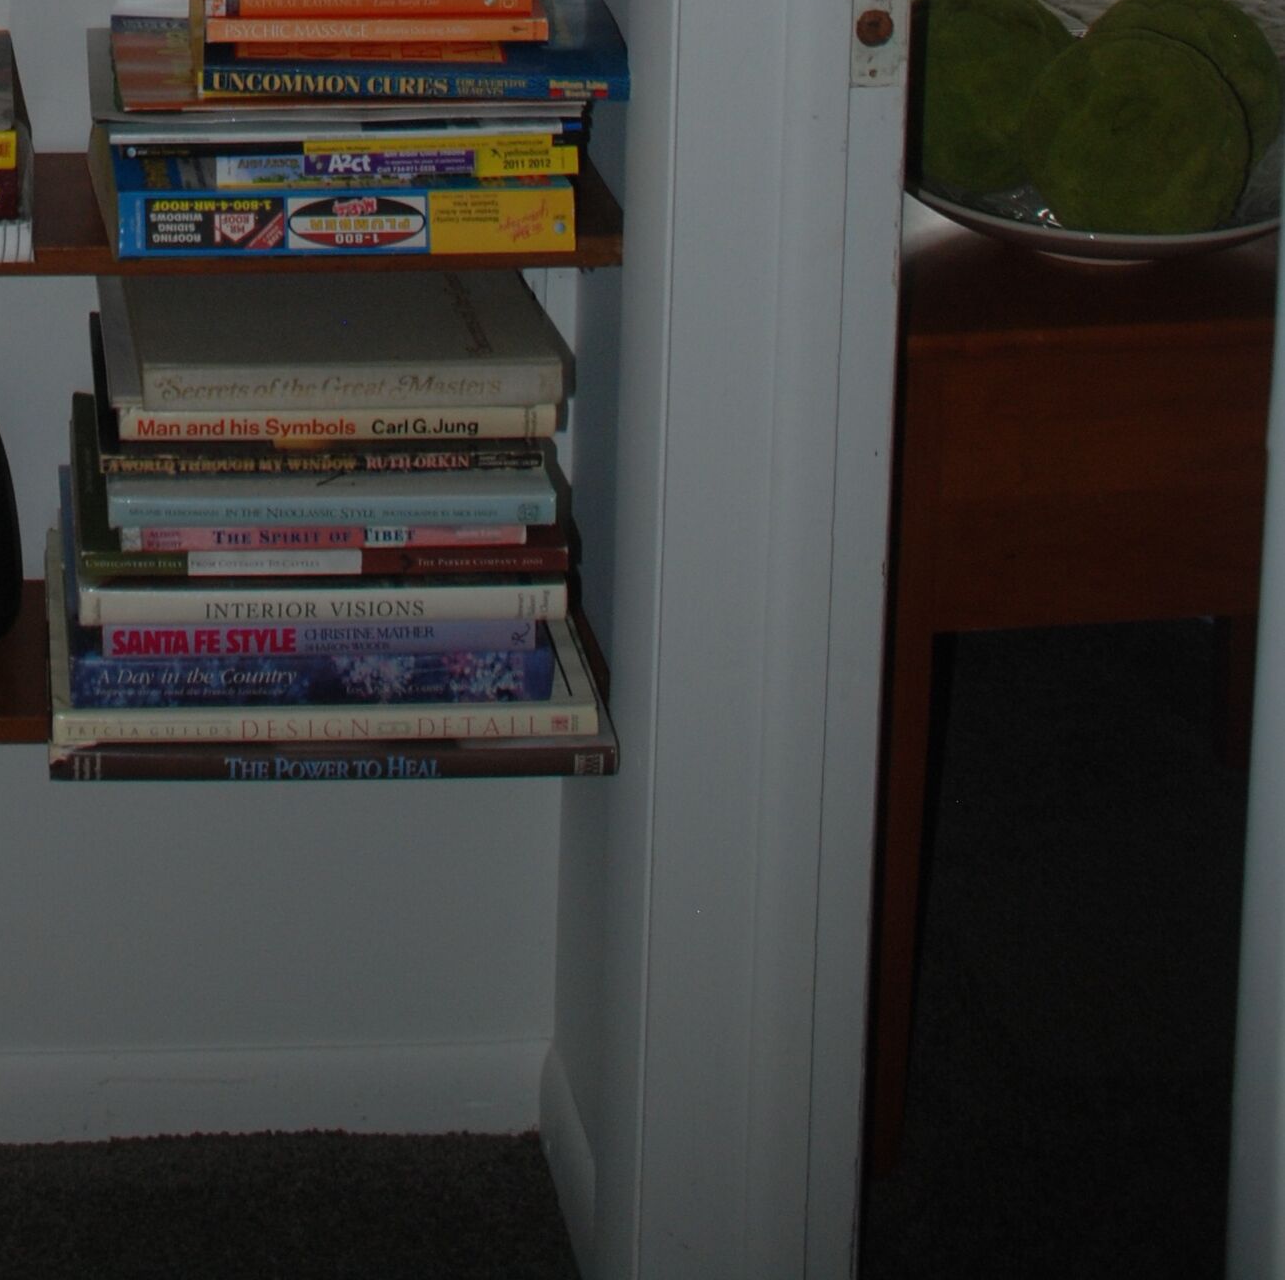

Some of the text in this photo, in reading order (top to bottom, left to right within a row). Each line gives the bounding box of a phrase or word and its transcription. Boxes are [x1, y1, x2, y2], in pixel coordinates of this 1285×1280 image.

[224, 22, 368, 38] PSYCHIC MASSAGE
[212, 72, 447, 95] UNCOMMON CURES
[503, 158, 551, 170] 2011 2012
[152, 200, 272, 212] 1-800-4-MR-ROOF
[150, 212, 203, 222] WINDOWS
[158, 222, 195, 231] SIDING
[152, 233, 202, 243] ROOFING
[335, 234, 378, 244] 1-800
[137, 418, 356, 439] Man and his Symbols
[371, 418, 409, 434] Carl
[437, 419, 479, 438] Jung
[213, 527, 414, 545] THE SPIRIT OF TIBET
[205, 600, 425, 620] INTERIOR VISIONS
[112, 629, 296, 655] SANTA FE STYLE
[304, 625, 435, 641] CHRISTINE MATHER
[97, 668, 298, 690] A Day in the Country
[240, 717, 540, 739] DESIGN DETAIL
[224, 757, 441, 779] THE POWER TO HEAL
